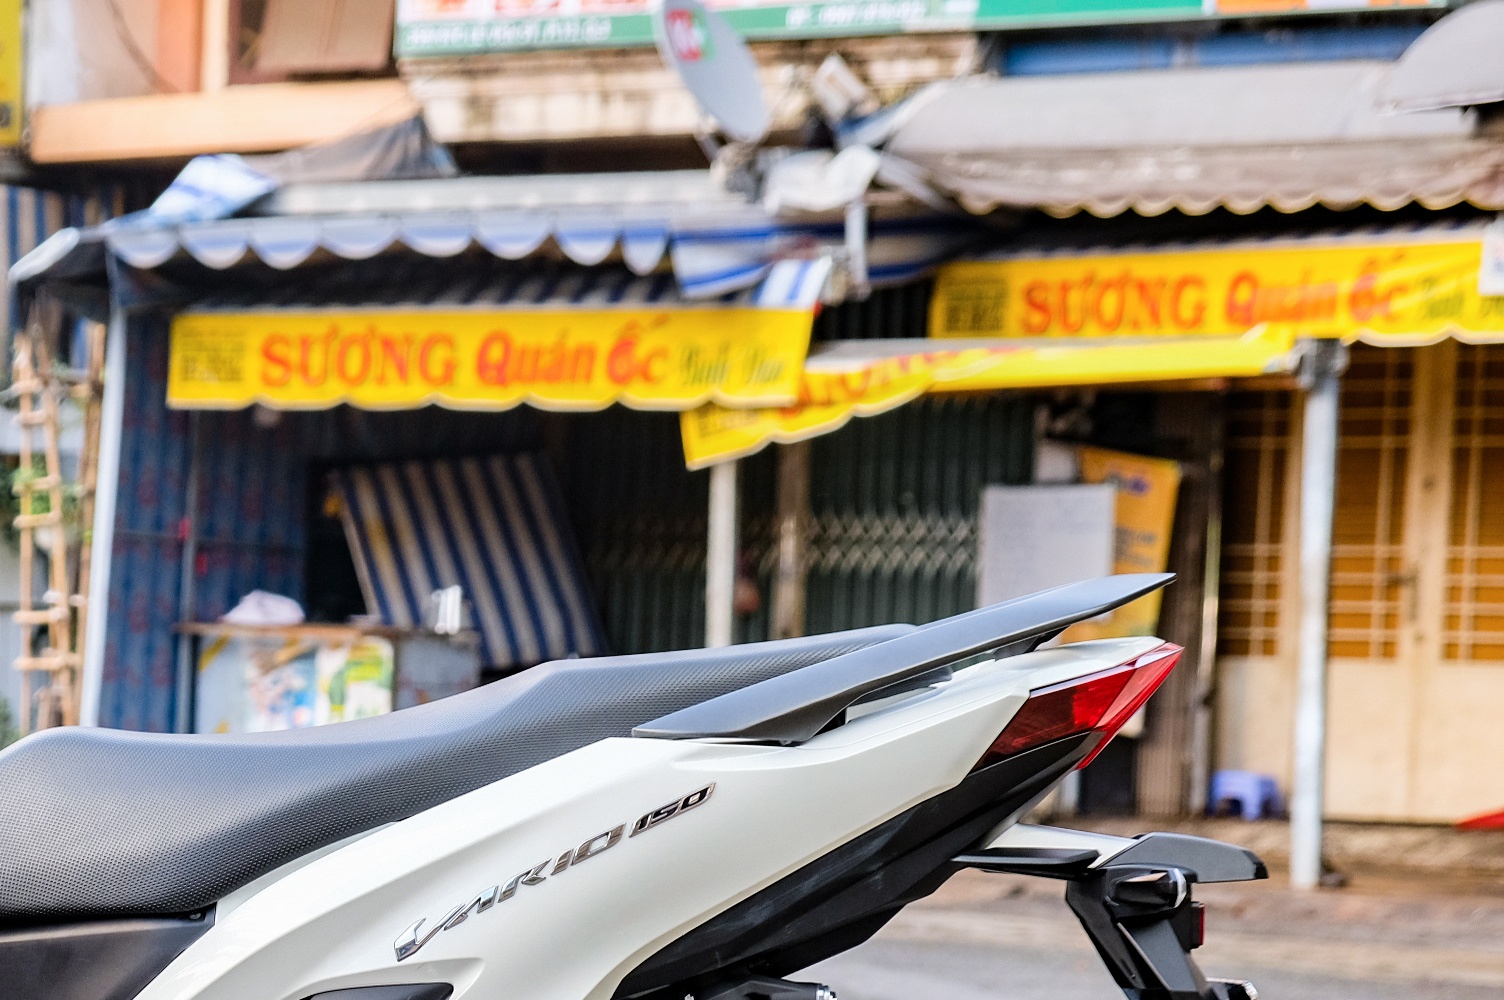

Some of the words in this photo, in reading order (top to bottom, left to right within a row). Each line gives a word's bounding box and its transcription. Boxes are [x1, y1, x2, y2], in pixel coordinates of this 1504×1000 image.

[1021, 270, 1208, 334] SƯƠNG
[1225, 269, 1339, 328] Quán
[259, 325, 458, 388] SƯƠNG
[476, 329, 597, 388] Quán
[606, 315, 670, 386] Ốc
[394, 822, 626, 962] VARIO
[628, 782, 717, 838] 150
